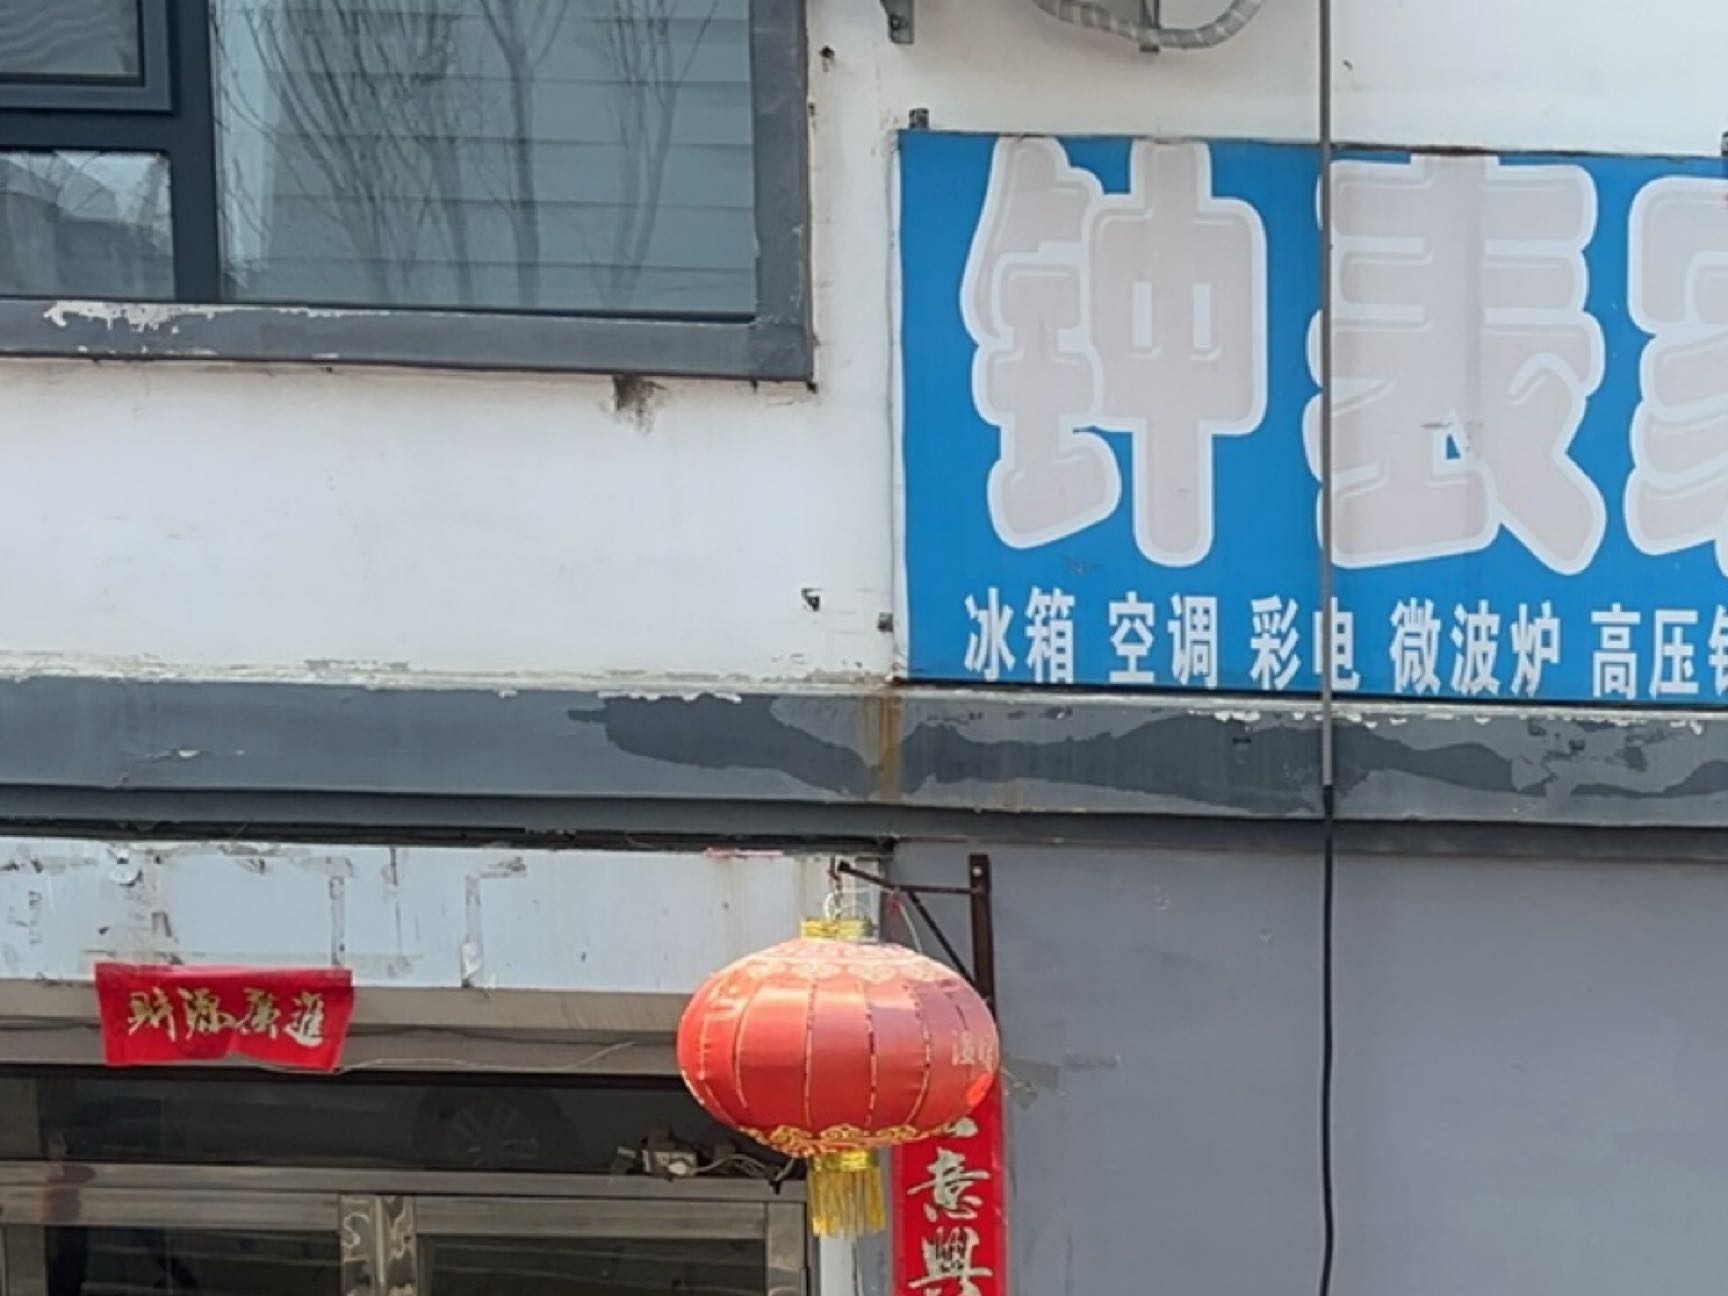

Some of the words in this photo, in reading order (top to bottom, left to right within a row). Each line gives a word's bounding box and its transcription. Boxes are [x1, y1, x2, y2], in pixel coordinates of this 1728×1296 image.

[964, 586, 1076, 684] 冰箱
[1108, 590, 1219, 689] 空调
[1249, 594, 1361, 692] 彩电
[1388, 597, 1562, 697] 微波炉
